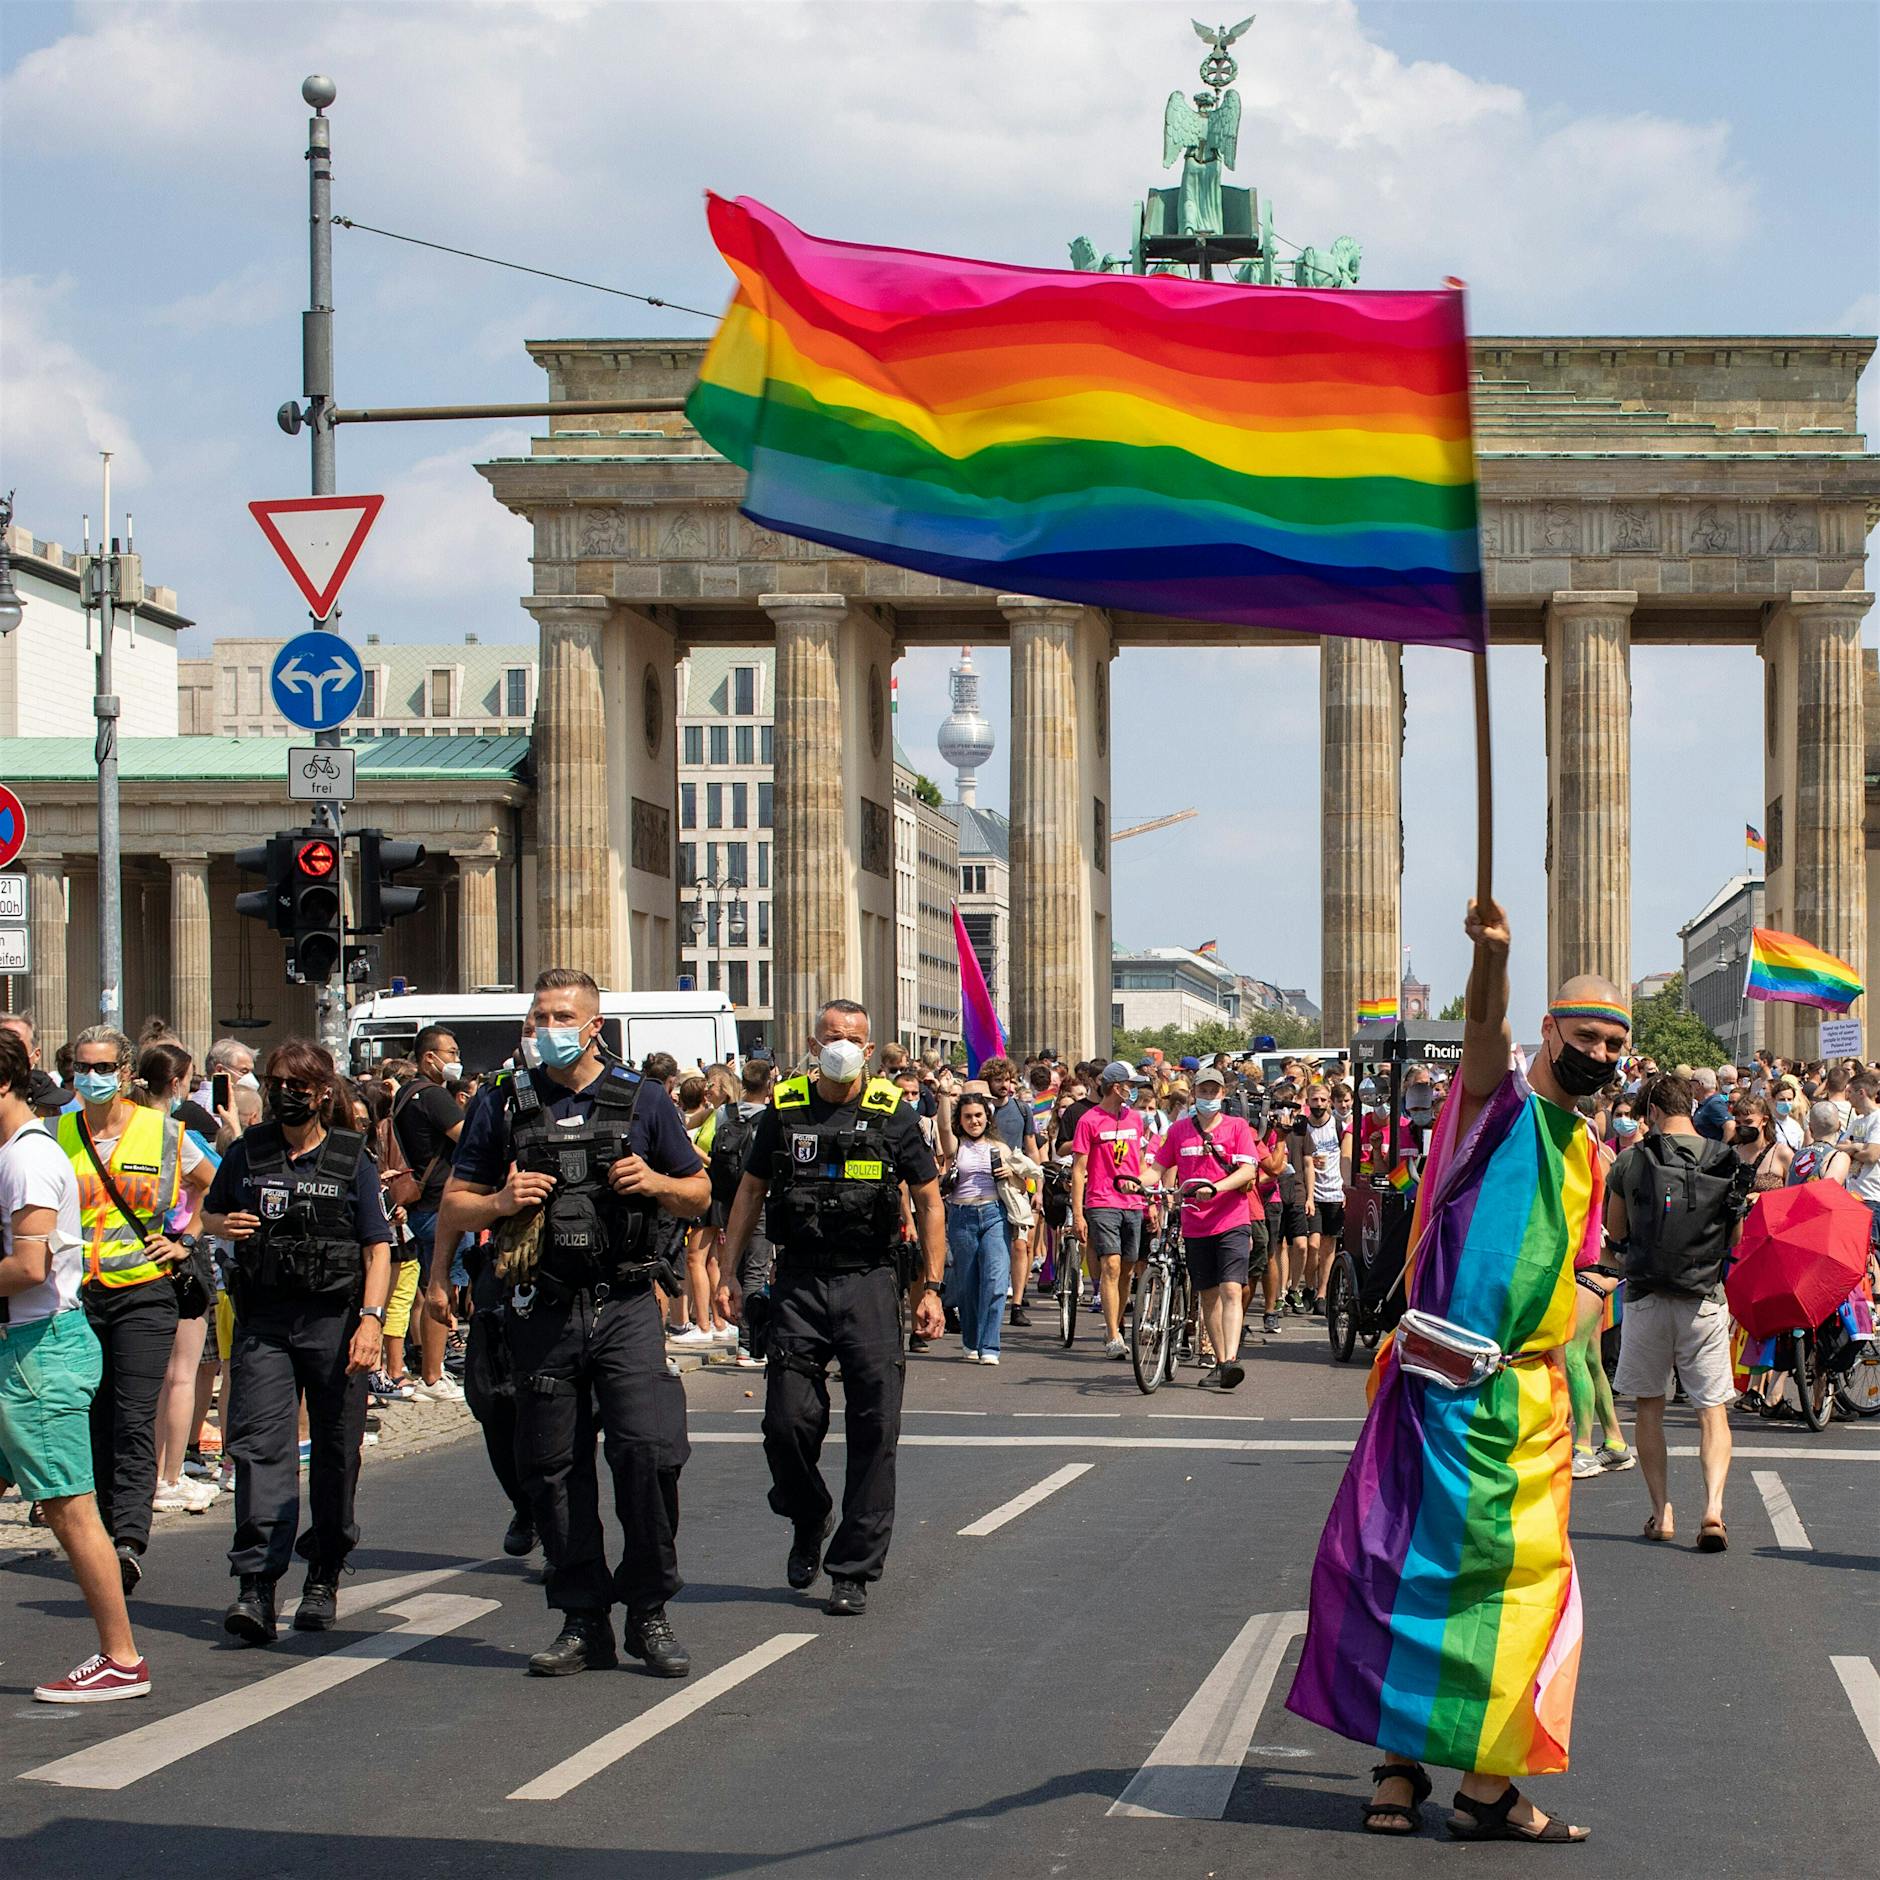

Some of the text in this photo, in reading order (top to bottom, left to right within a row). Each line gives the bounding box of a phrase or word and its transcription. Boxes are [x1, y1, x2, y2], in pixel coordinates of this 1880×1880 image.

[312, 782, 332, 793] frei
[848, 1164, 880, 1176] POLIZEI
[297, 1182, 339, 1197] POLIZEI
[555, 1233, 588, 1246] POLIZEI
